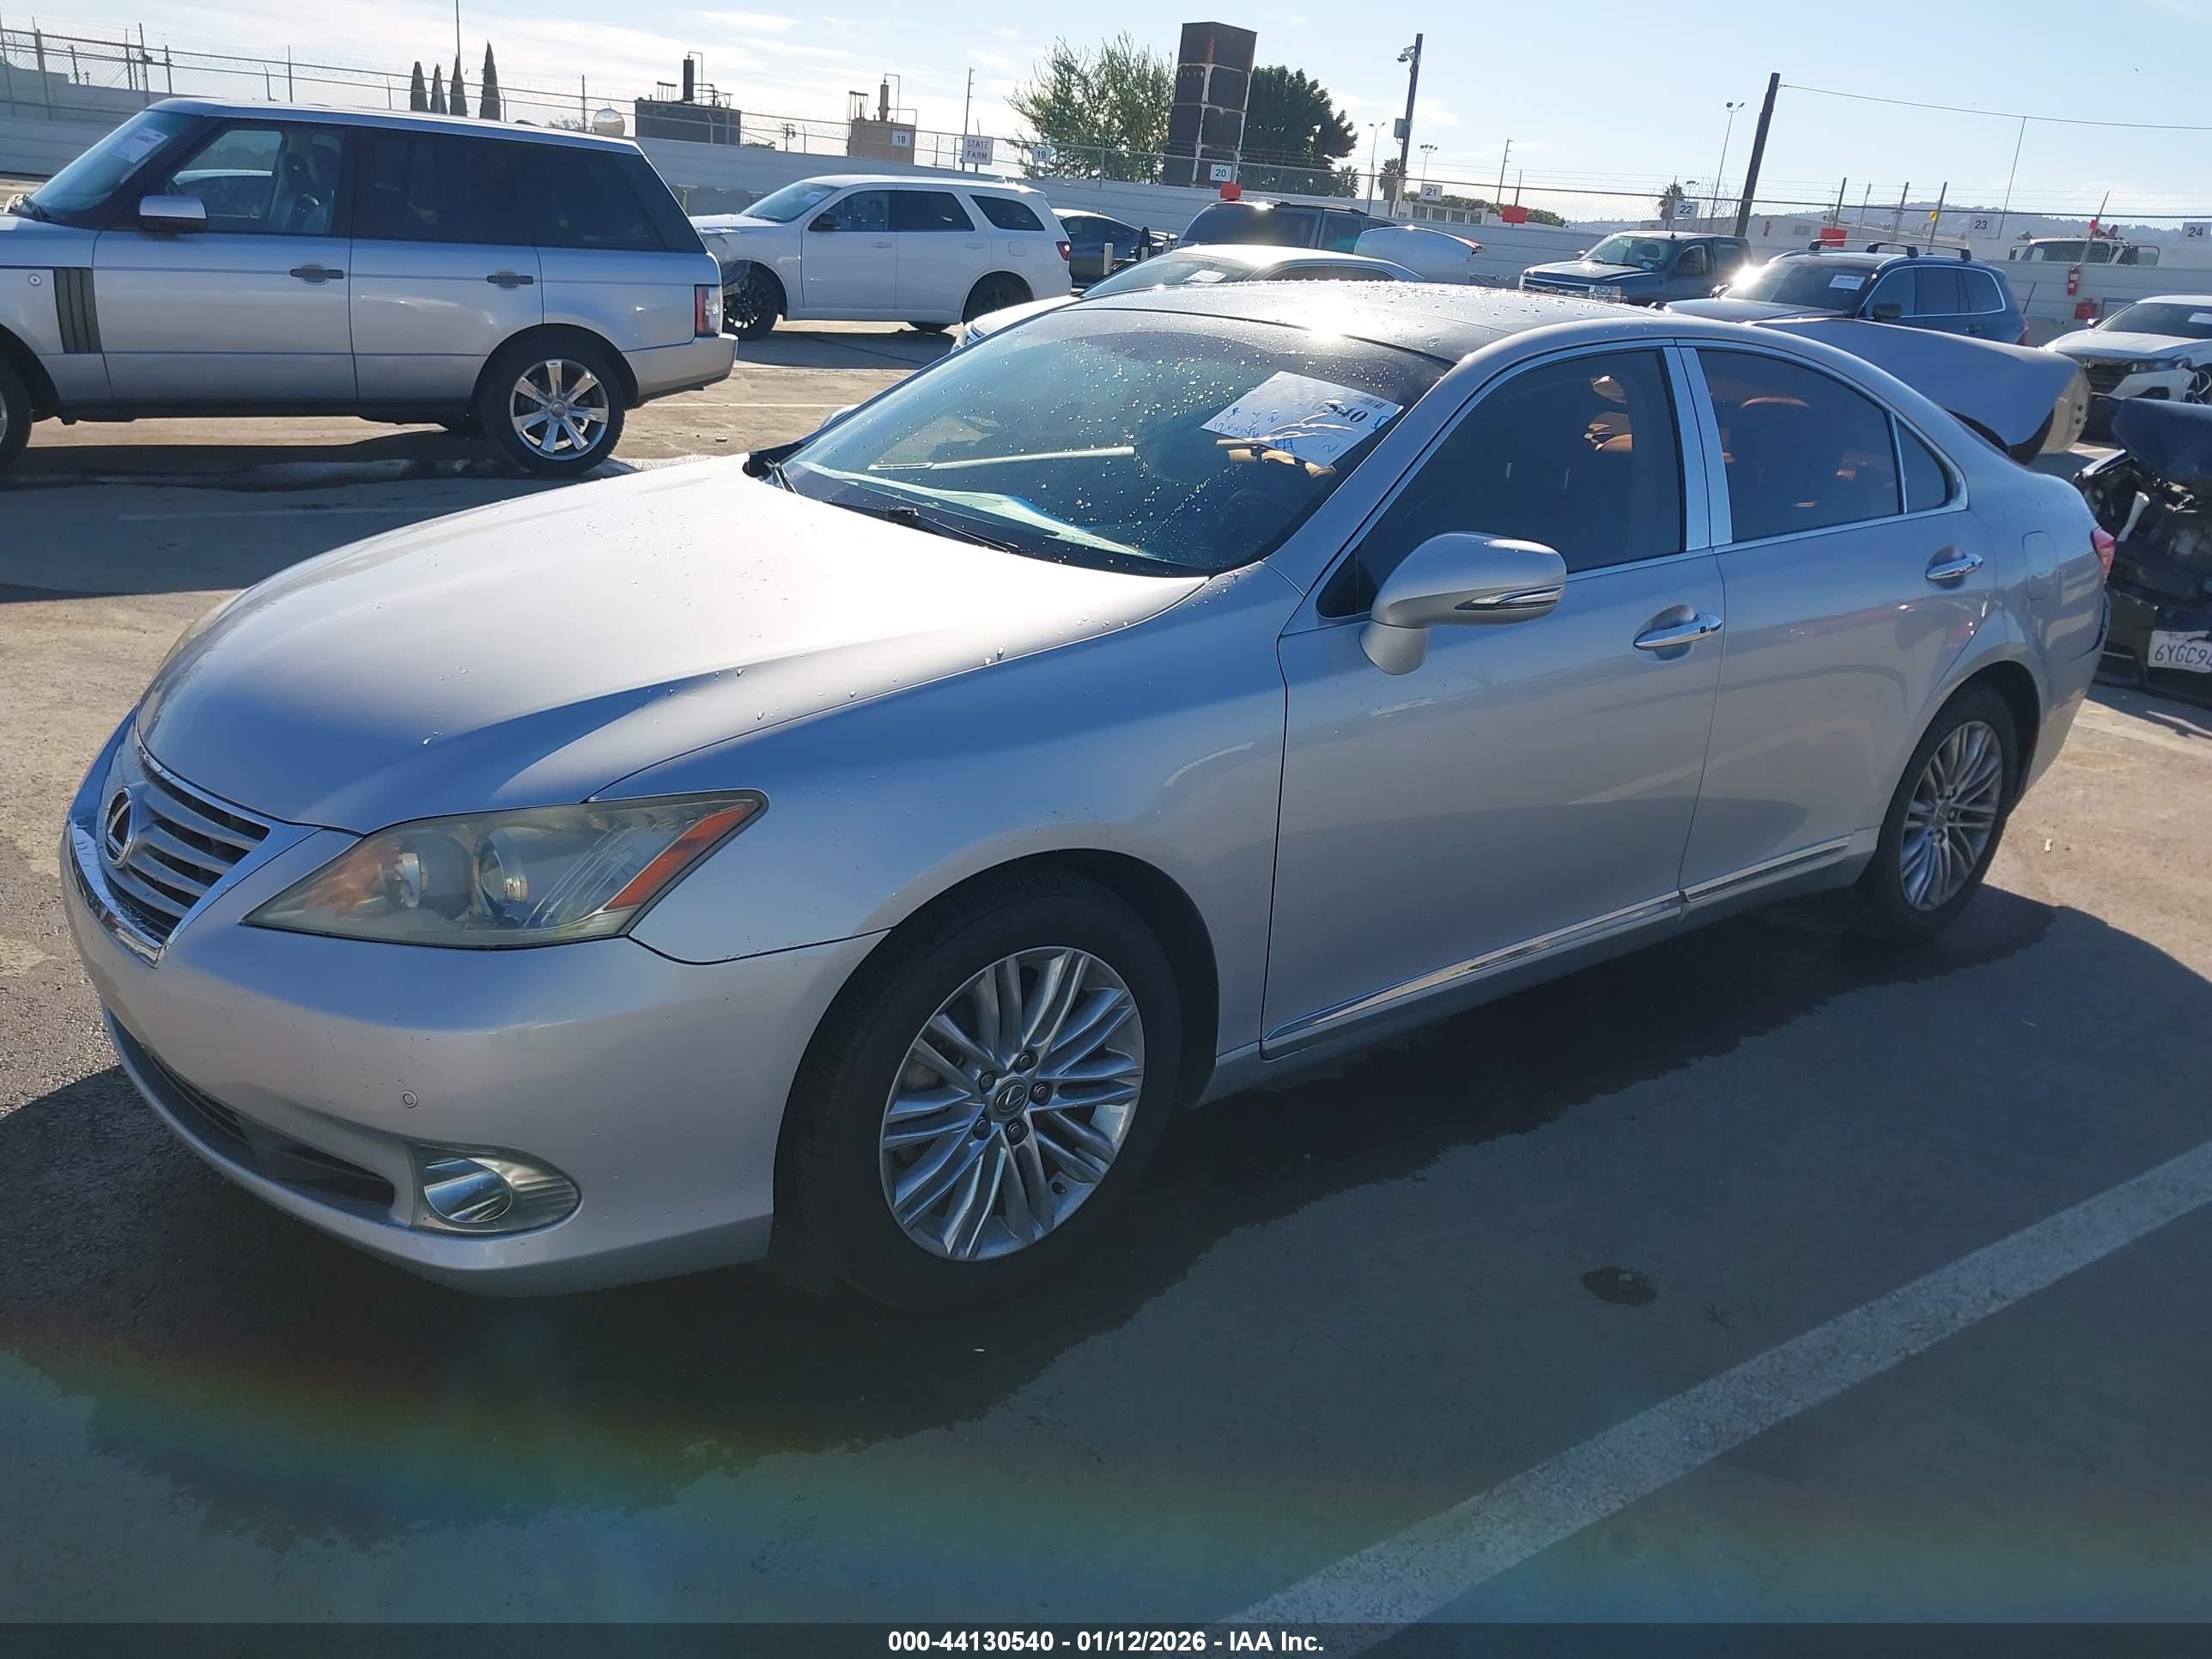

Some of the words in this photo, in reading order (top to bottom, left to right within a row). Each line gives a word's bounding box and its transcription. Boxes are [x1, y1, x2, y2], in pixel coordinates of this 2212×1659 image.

[896, 135, 906, 144] 18
[966, 139, 989, 149] STATE
[966, 150, 988, 161] FARM
[1036, 150, 1047, 160] 19
[1215, 168, 1227, 178] 20
[1425, 187, 1437, 197] 21
[1679, 204, 1693, 215] 22
[1974, 219, 1988, 230] 23
[2187, 226, 2204, 238] 24
